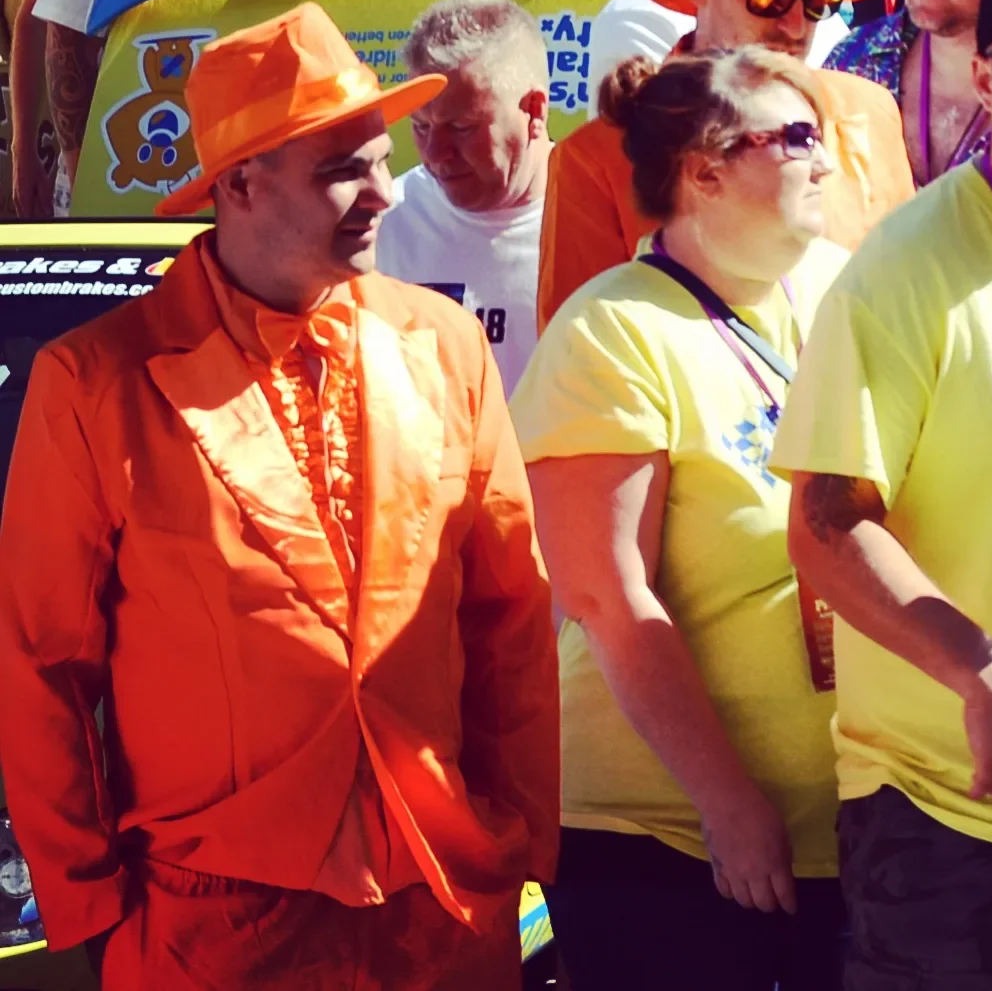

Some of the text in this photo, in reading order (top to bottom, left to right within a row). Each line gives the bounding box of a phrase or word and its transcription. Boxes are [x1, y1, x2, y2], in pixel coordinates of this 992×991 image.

[388, 30, 410, 41] ven
[0, 257, 104, 275] akes
[106, 258, 142, 275] &
[0, 281, 153, 297] ustombrakes.c
